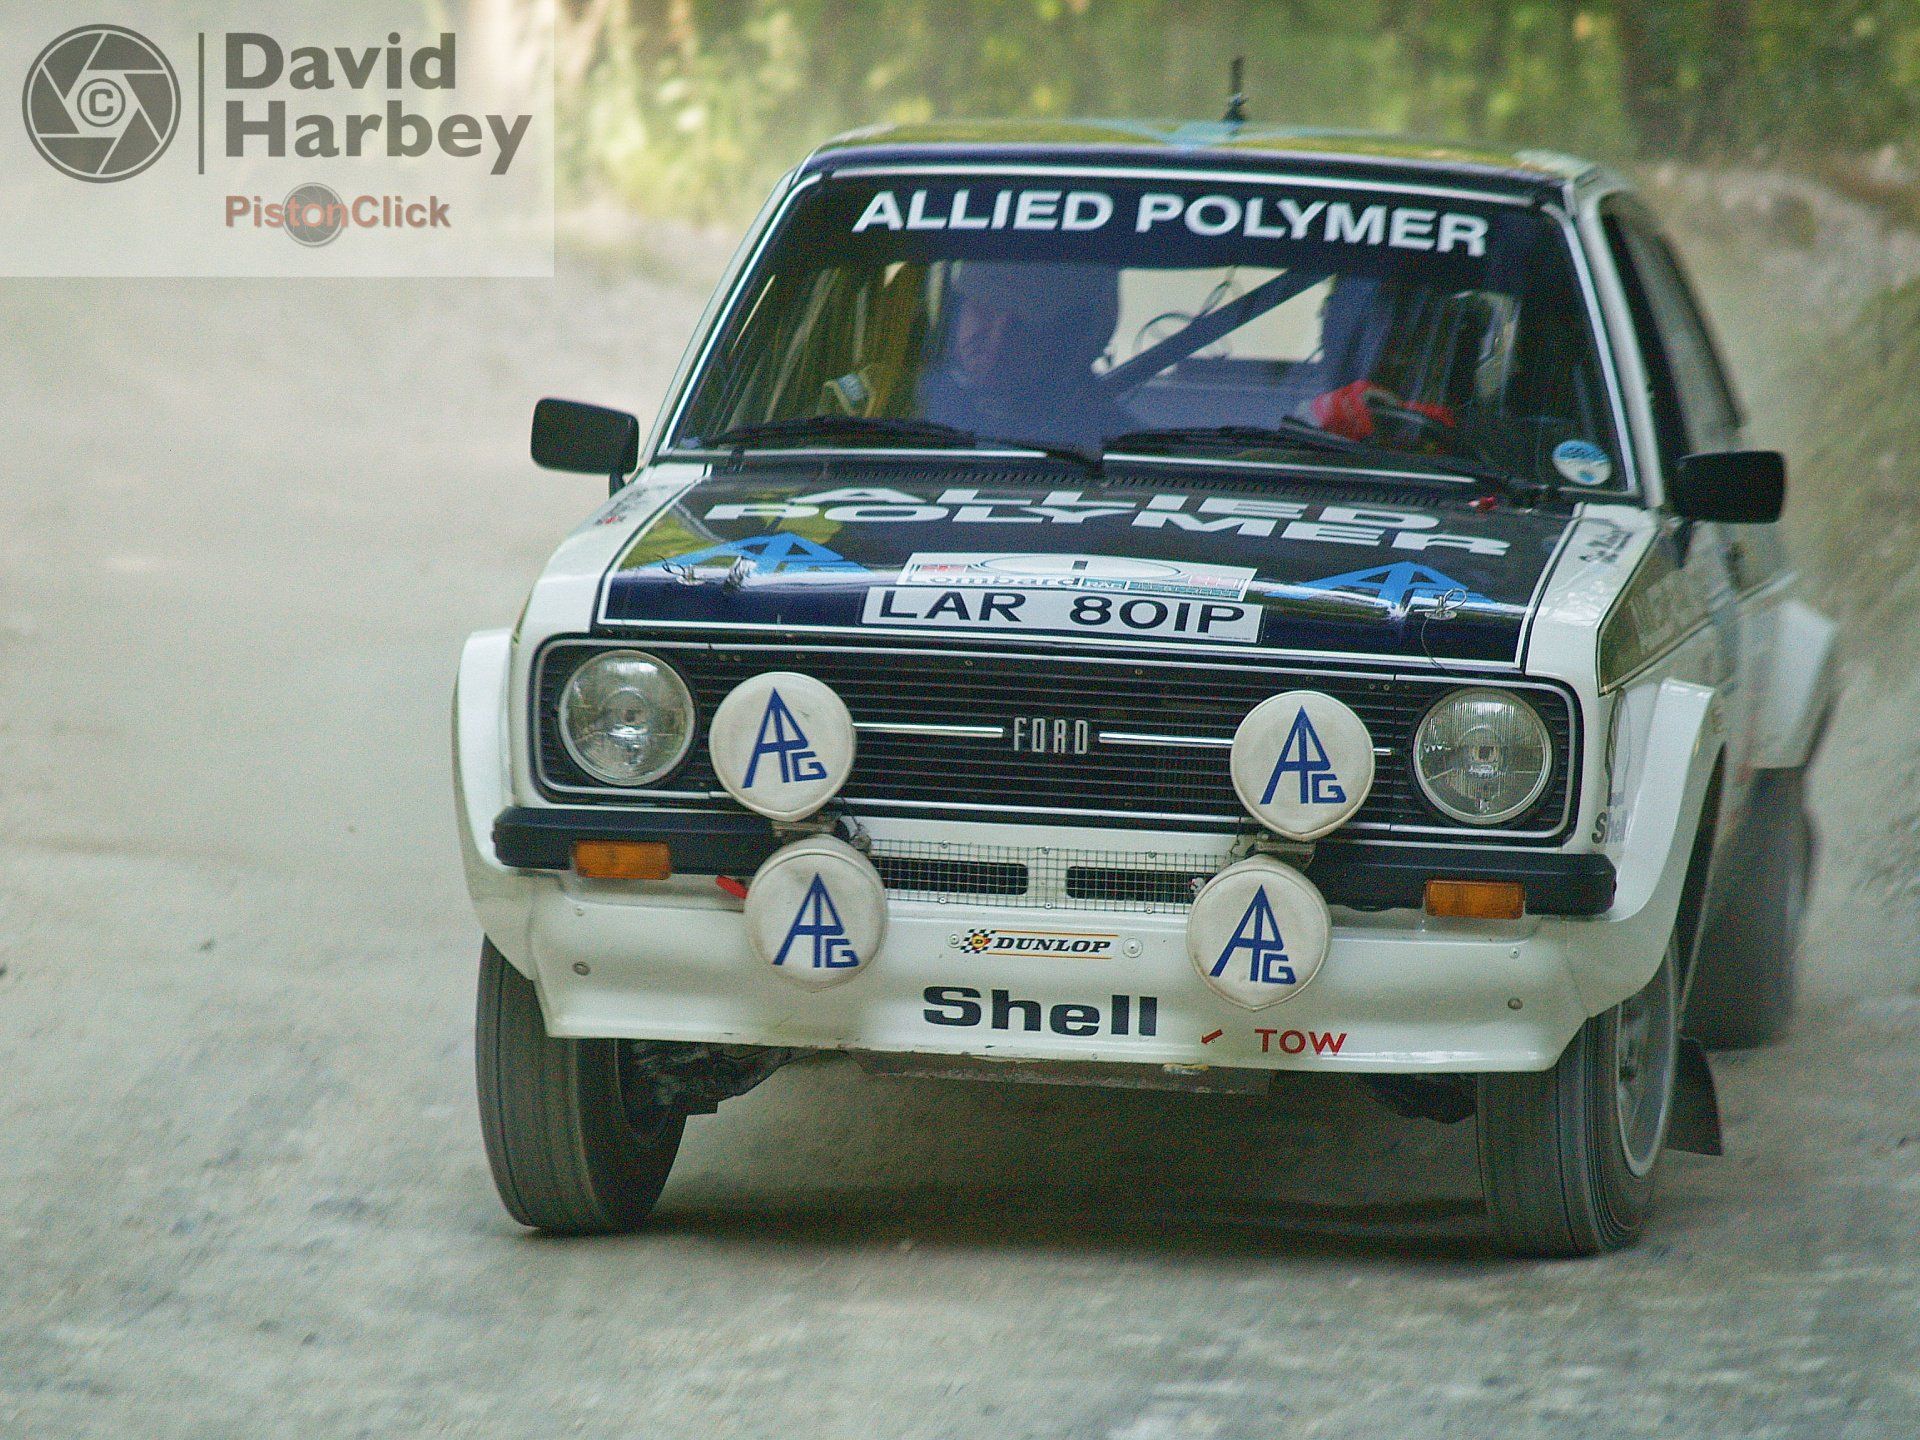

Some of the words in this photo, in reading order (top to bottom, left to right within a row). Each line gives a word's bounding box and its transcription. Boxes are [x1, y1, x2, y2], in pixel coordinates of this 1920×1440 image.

[852, 189, 1113, 233] ALLIED
[1135, 193, 1489, 258] POLYMER
[705, 503, 1511, 556] POLYMER
[789, 488, 1441, 532] ALLIED
[877, 589, 1025, 623] LAR
[1069, 595, 1245, 634] 801P
[1013, 716, 1088, 755] FORD
[993, 936, 1111, 953] DUNLOP
[923, 986, 1158, 1037] Shell
[1254, 1028, 1348, 1056] TOW
